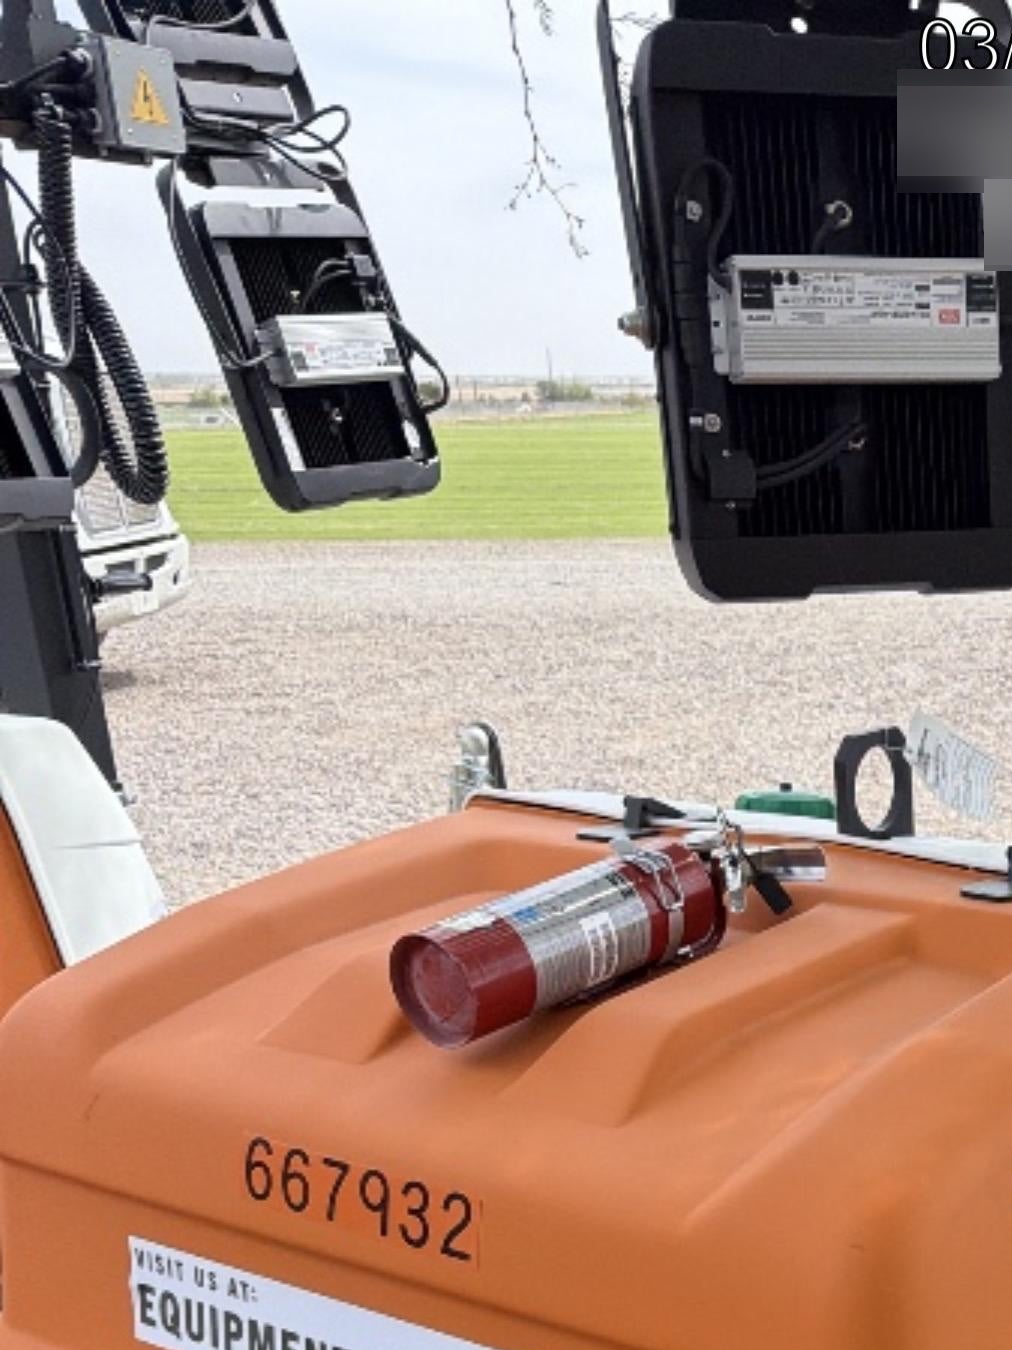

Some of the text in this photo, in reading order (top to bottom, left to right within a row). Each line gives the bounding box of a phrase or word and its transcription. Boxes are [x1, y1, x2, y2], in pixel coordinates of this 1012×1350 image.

[245, 1137, 472, 1261] 667932
[134, 1248, 258, 1302] VISIT US AT:
